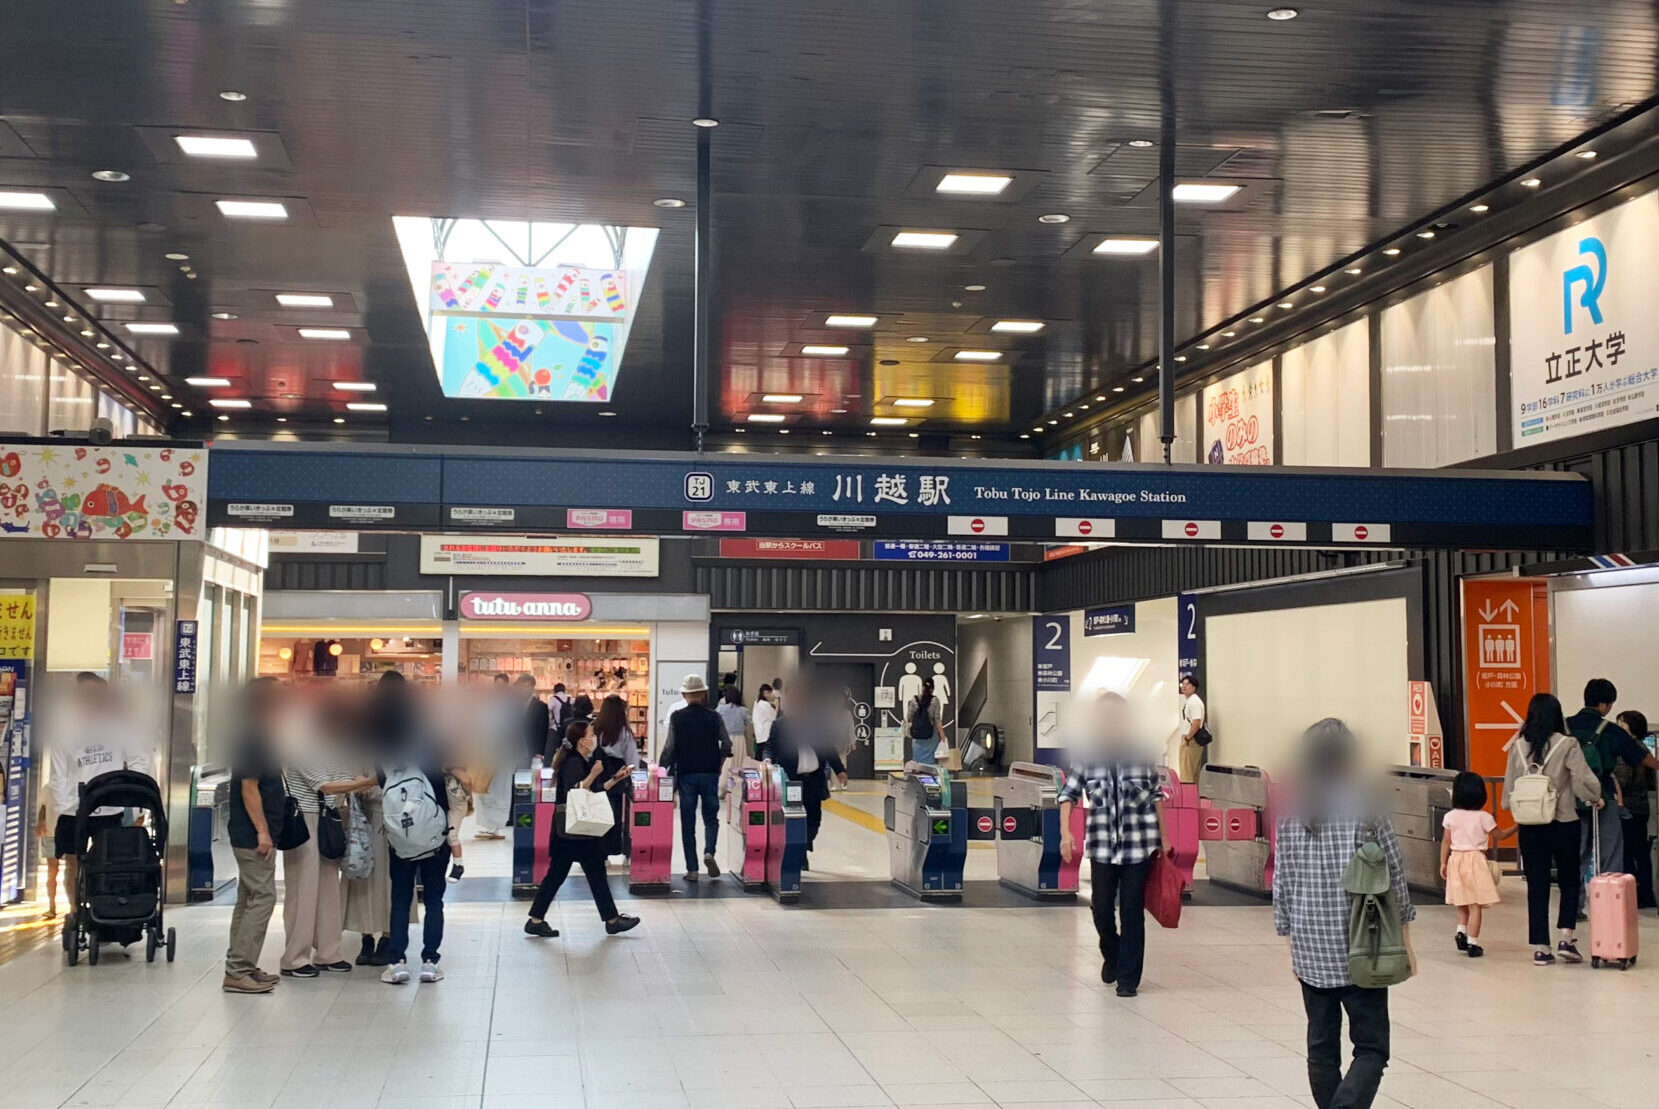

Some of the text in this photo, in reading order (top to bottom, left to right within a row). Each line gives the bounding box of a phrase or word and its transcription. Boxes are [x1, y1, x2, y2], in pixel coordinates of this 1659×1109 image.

[1545, 330, 1626, 385] 立正大学
[694, 478, 706, 486] TJ
[726, 480, 816, 496] 東武東上線
[832, 473, 951, 506] 川越駅
[692, 486, 707, 496] 21
[974, 487, 1187, 504] Tobu Tojo Line Kawagoe Station
[758, 541, 823, 550] 当駅からスクールバス
[917, 551, 978, 560] 049-261-0001
[0, 601, 33, 620] せん
[470, 597, 582, 617] tutu anna
[1187, 603, 1196, 640] 2
[0, 626, 32, 640] きません
[1045, 622, 1063, 650] 2
[909, 651, 941, 660] Toilets
[176, 637, 192, 692] 東武東上線
[746, 780, 761, 791] IC
